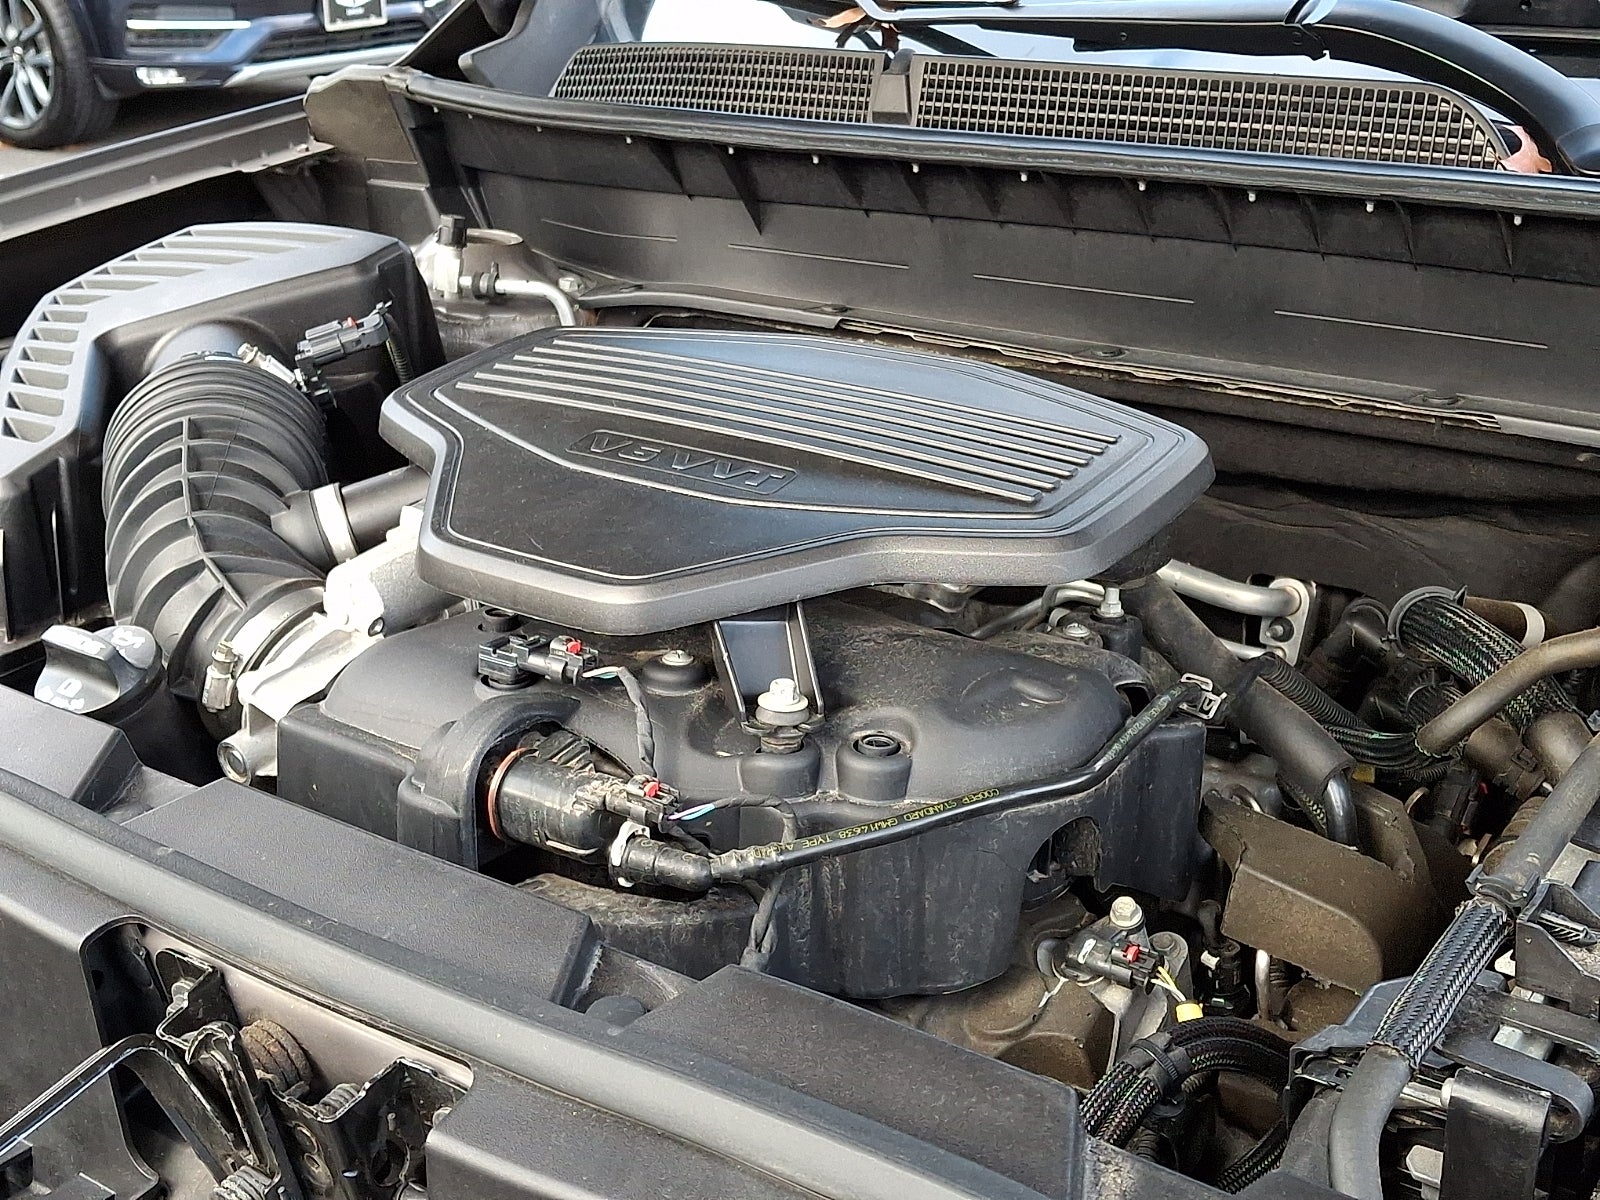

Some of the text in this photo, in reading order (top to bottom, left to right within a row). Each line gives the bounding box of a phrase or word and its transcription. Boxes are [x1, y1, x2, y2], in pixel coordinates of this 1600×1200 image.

[590, 435, 786, 487] V6 VVT
[962, 788, 1000, 805] COOPER
[903, 801, 957, 822] STANDARD
[802, 833, 833, 849] TYPE
